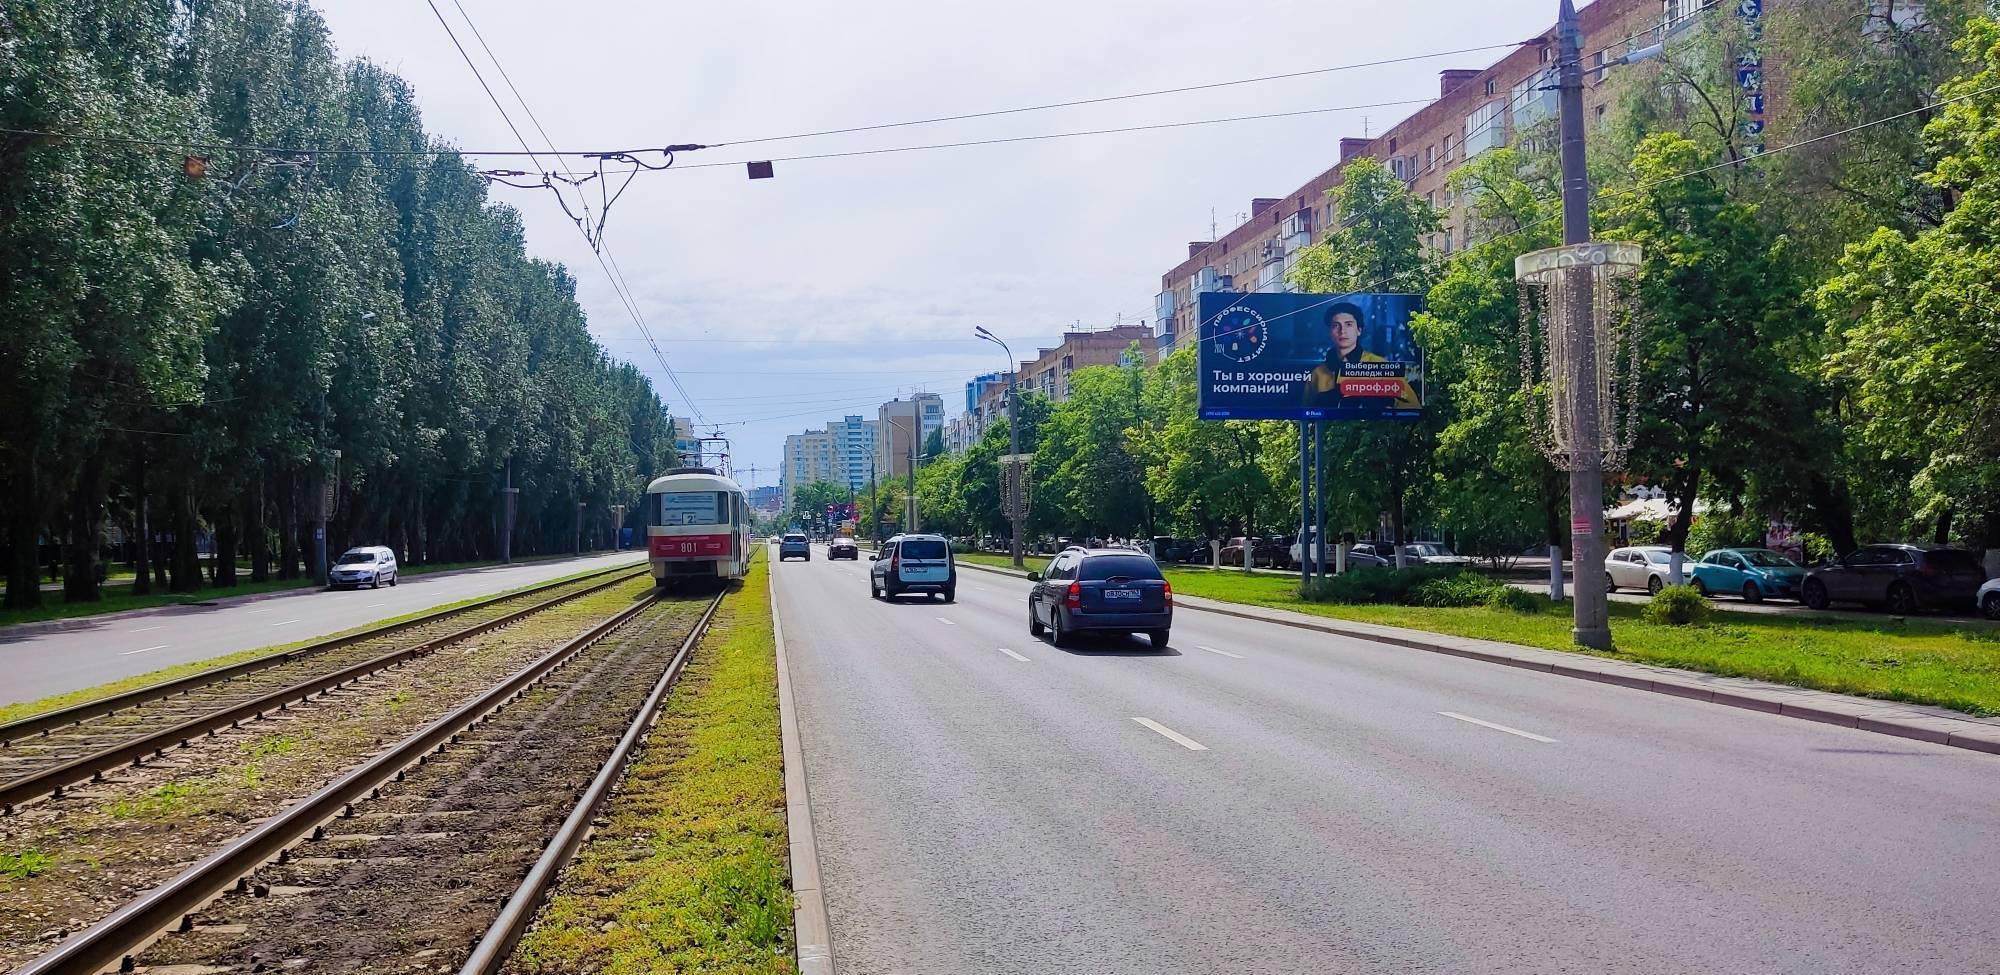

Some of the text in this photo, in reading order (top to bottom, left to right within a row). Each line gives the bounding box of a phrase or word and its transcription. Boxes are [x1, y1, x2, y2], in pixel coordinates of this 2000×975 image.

[1213, 305, 1268, 363] ПРОФЕССИОНАЛИТЕТ
[1345, 362, 1379, 370] Выбери
[1212, 370, 1312, 383] Ты в хорошей
[1345, 370, 1383, 378] колледж
[1213, 383, 1289, 393] компании!
[1345, 382, 1400, 393] япроф.рф
[680, 542, 697, 553] 801
